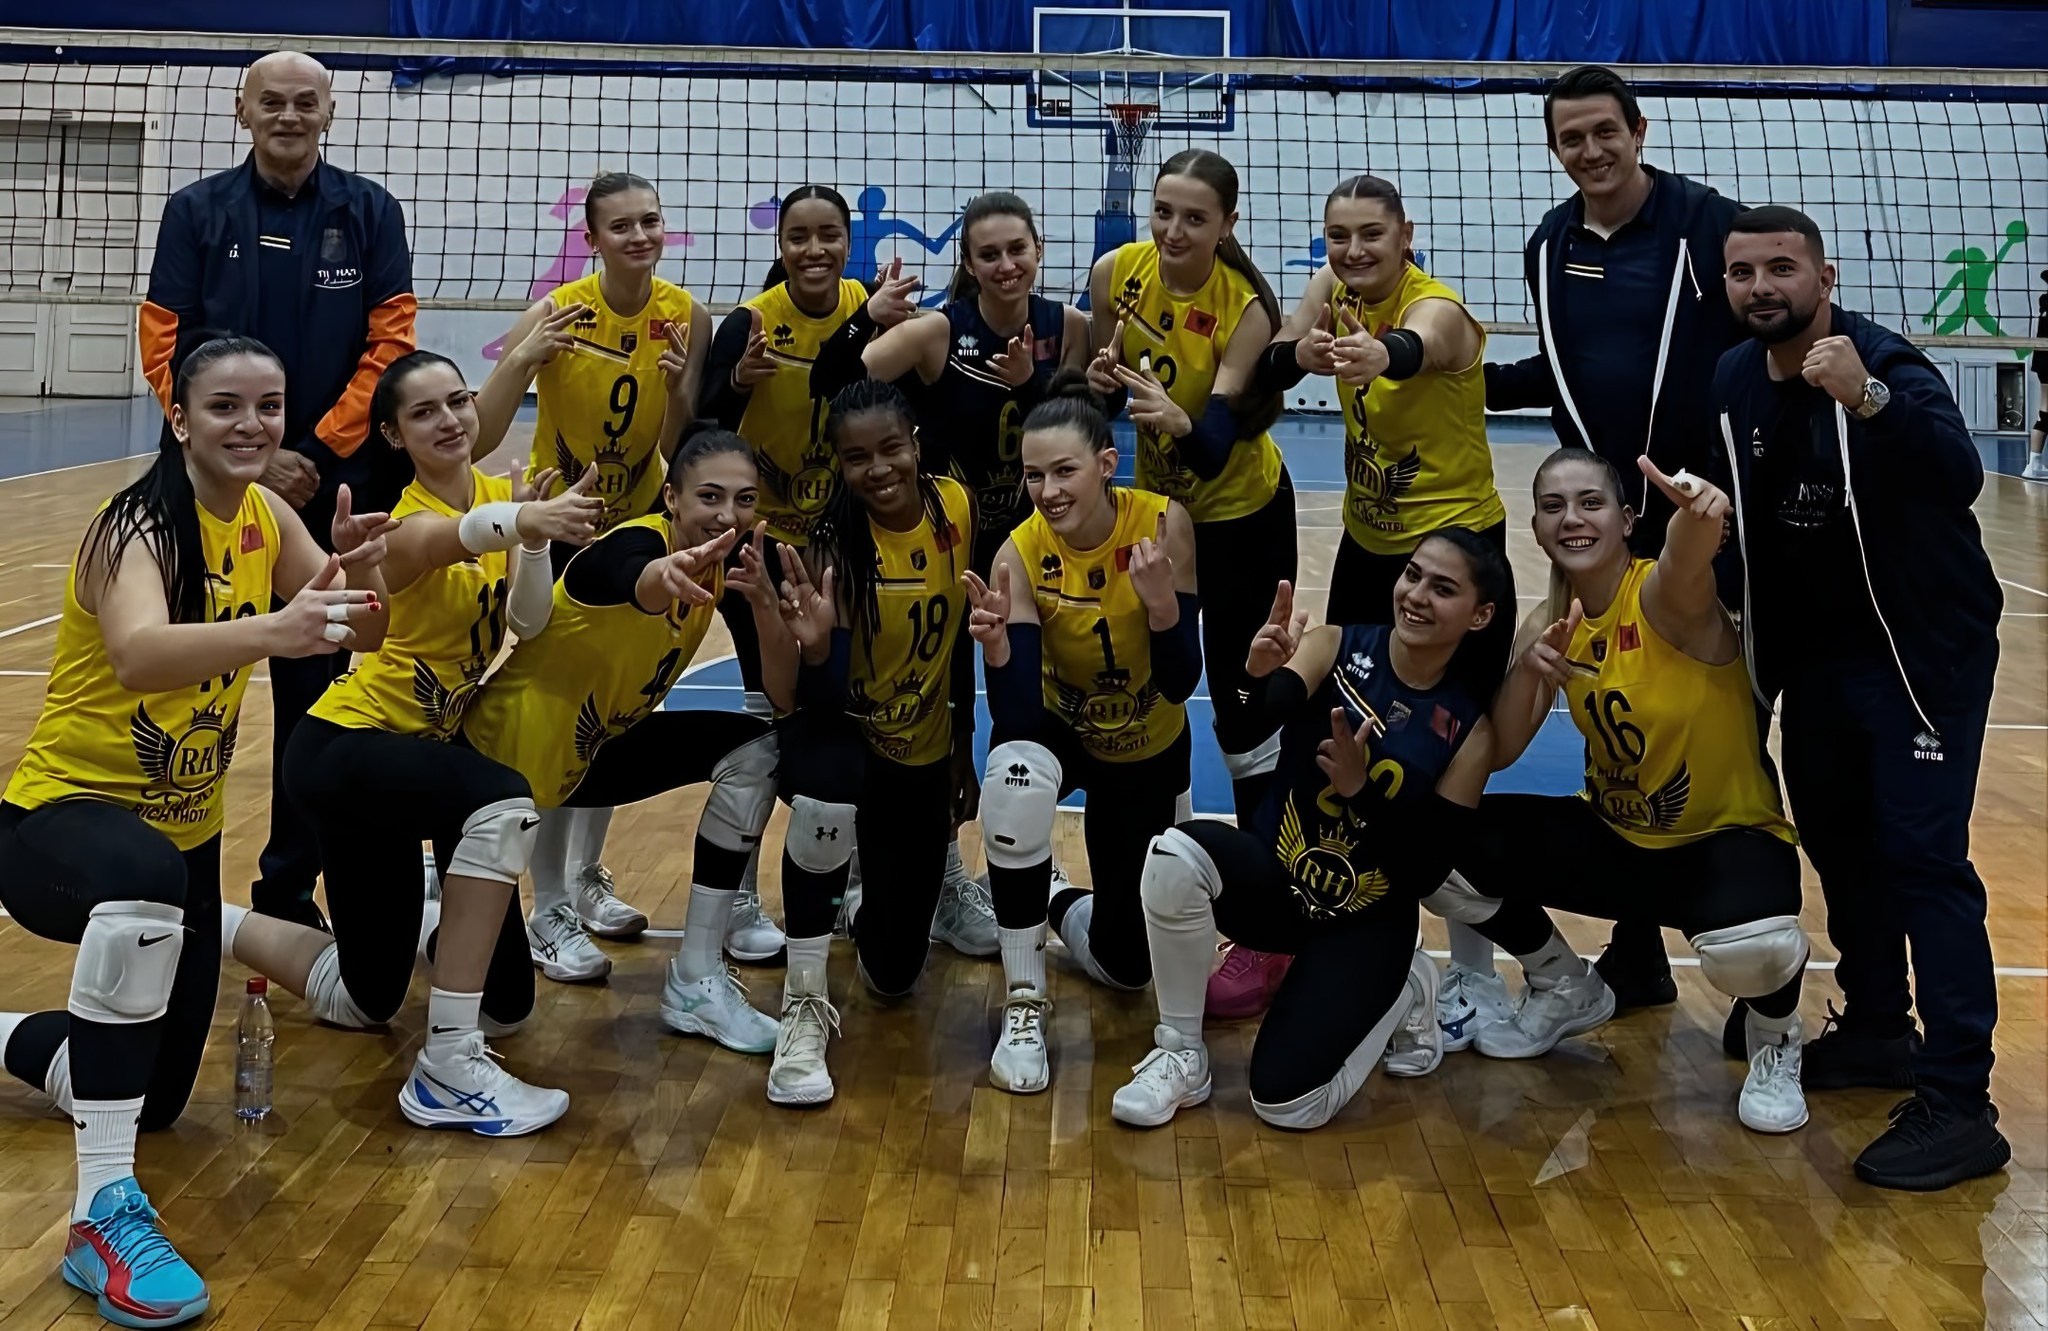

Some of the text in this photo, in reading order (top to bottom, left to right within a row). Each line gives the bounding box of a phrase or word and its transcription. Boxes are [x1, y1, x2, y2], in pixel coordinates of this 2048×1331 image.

[604, 375, 638, 438] 9
[999, 400, 1026, 461] 6
[798, 480, 830, 500] RH
[908, 594, 948, 664] 18
[1092, 617, 1124, 676] 1
[1585, 690, 1645, 765] 16
[181, 744, 217, 777] RH
[1301, 858, 1350, 896] RH
